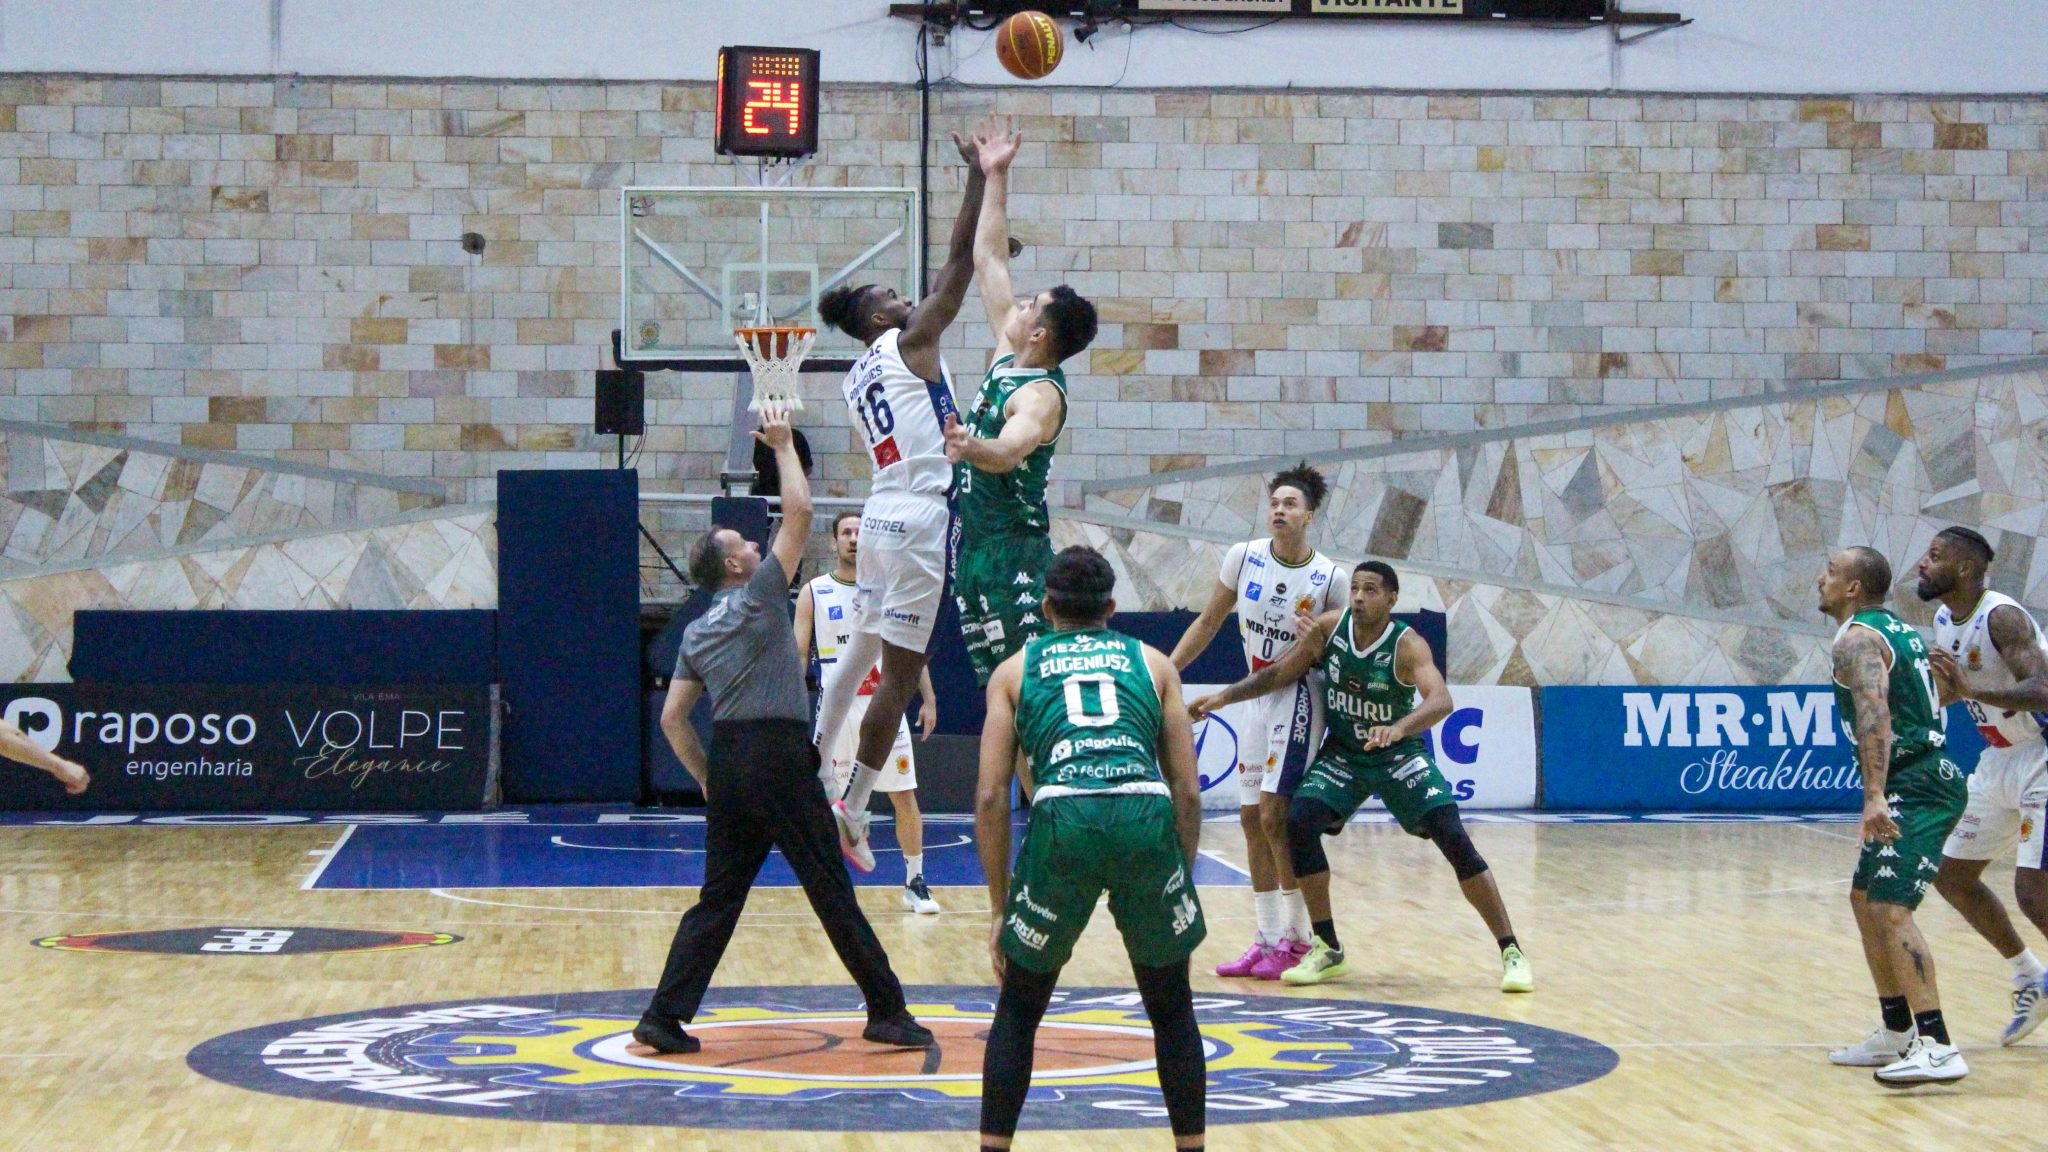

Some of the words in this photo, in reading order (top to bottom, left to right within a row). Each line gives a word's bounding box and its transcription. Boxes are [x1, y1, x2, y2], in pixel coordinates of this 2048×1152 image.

[1033, 16, 1056, 65] PENALTY
[743, 82, 799, 135] 24
[857, 382, 894, 444] 16
[864, 516, 907, 534] COTREL
[1039, 653, 1131, 679] EUGENIUSZ
[1042, 640, 1126, 657] MEZZANI
[1262, 638, 1273, 660] 0
[1062, 672, 1120, 727] 0
[1293, 684, 1310, 745] ARBORE
[1328, 687, 1392, 722] BAURU
[74, 711, 257, 754] raposo
[285, 710, 465, 750] VOLPE
[126, 757, 253, 780] engenharia
[293, 740, 451, 789] Elegance
[34, 811, 530, 825] JOSÉ
[260, 1004, 553, 1107] BASKETBALL
[1233, 1006, 1505, 1035] JOSÉ
[1394, 1036, 1536, 1064] DOS
